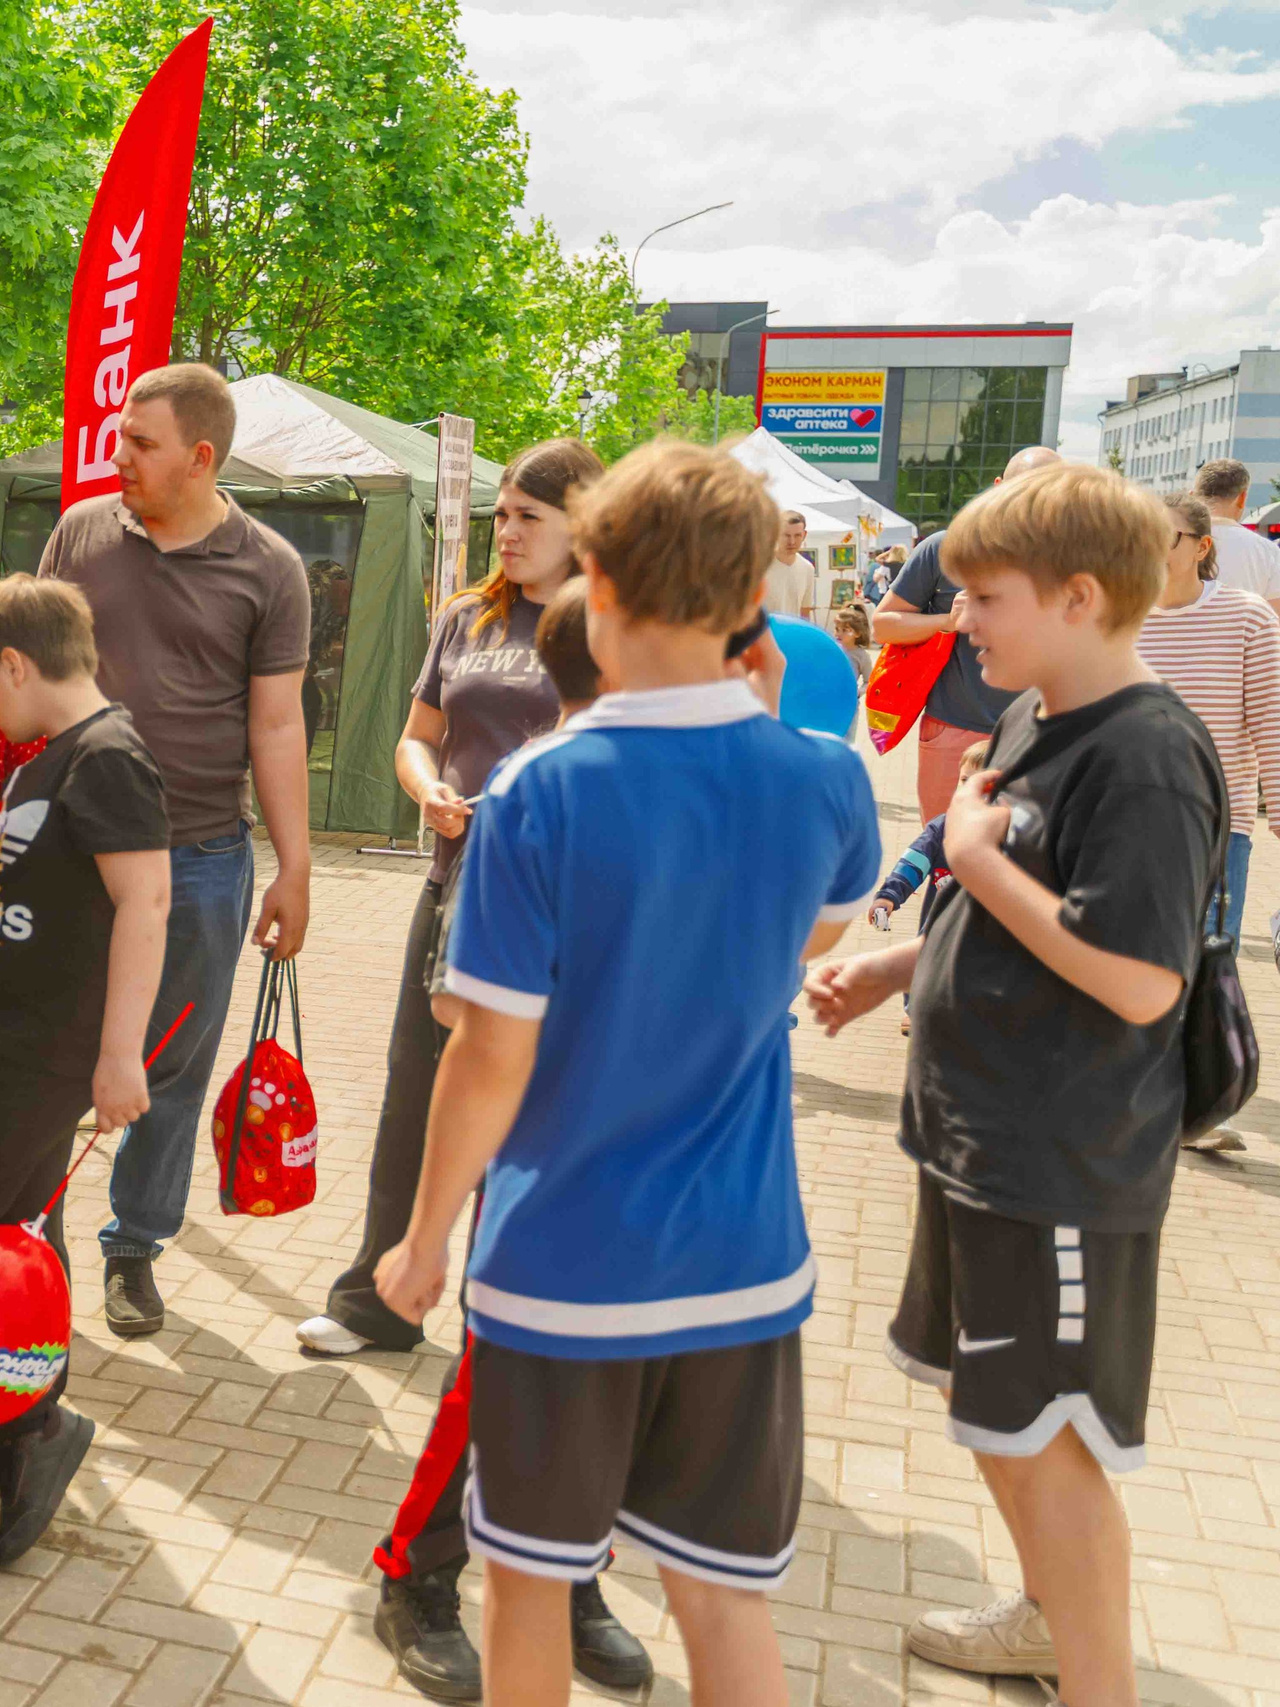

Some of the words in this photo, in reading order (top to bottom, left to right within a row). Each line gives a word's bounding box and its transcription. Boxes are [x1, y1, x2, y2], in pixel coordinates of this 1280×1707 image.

[76, 208, 145, 484] Банк
[765, 376, 822, 387] ЭКОНОМ
[826, 376, 881, 387] КАРМАН
[767, 408, 848, 421] здравсити
[795, 420, 847, 430] аптека
[450, 649, 524, 680] NEW
